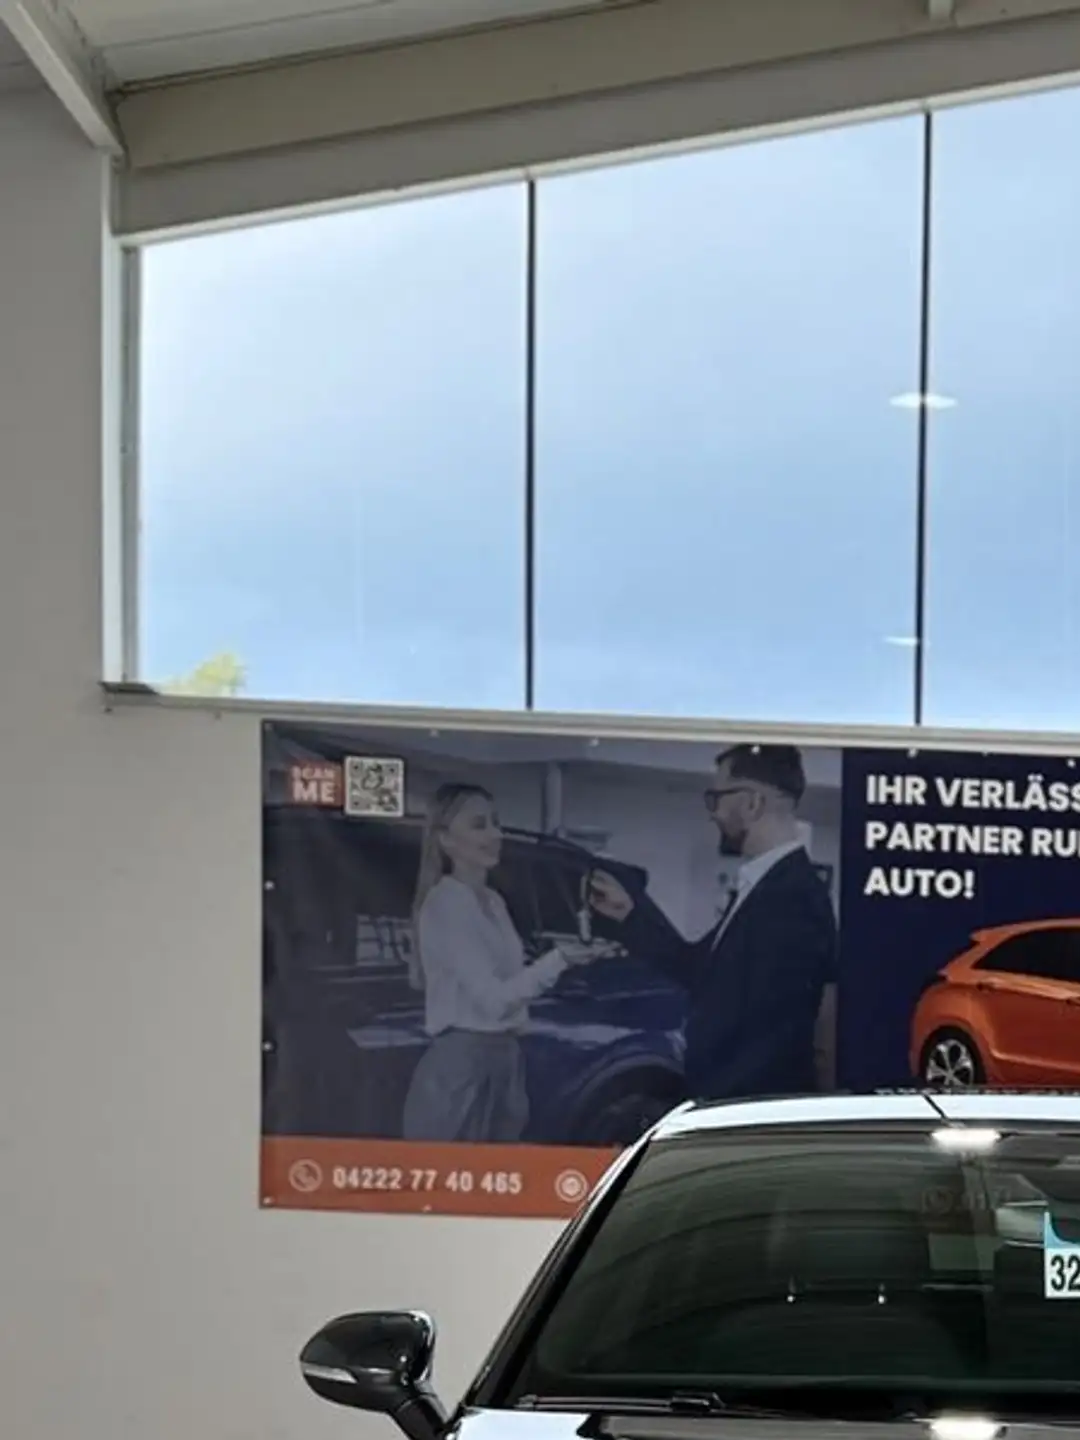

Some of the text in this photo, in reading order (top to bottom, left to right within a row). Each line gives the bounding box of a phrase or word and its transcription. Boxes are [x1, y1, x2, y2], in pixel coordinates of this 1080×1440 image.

[292, 780, 335, 802] ME
[866, 775, 927, 806] IHR
[865, 821, 1024, 856] PARTNER
[864, 867, 974, 899] AUTO!
[333, 1167, 402, 1190] 04222
[410, 1169, 437, 1190] 77
[445, 1170, 473, 1192] 40
